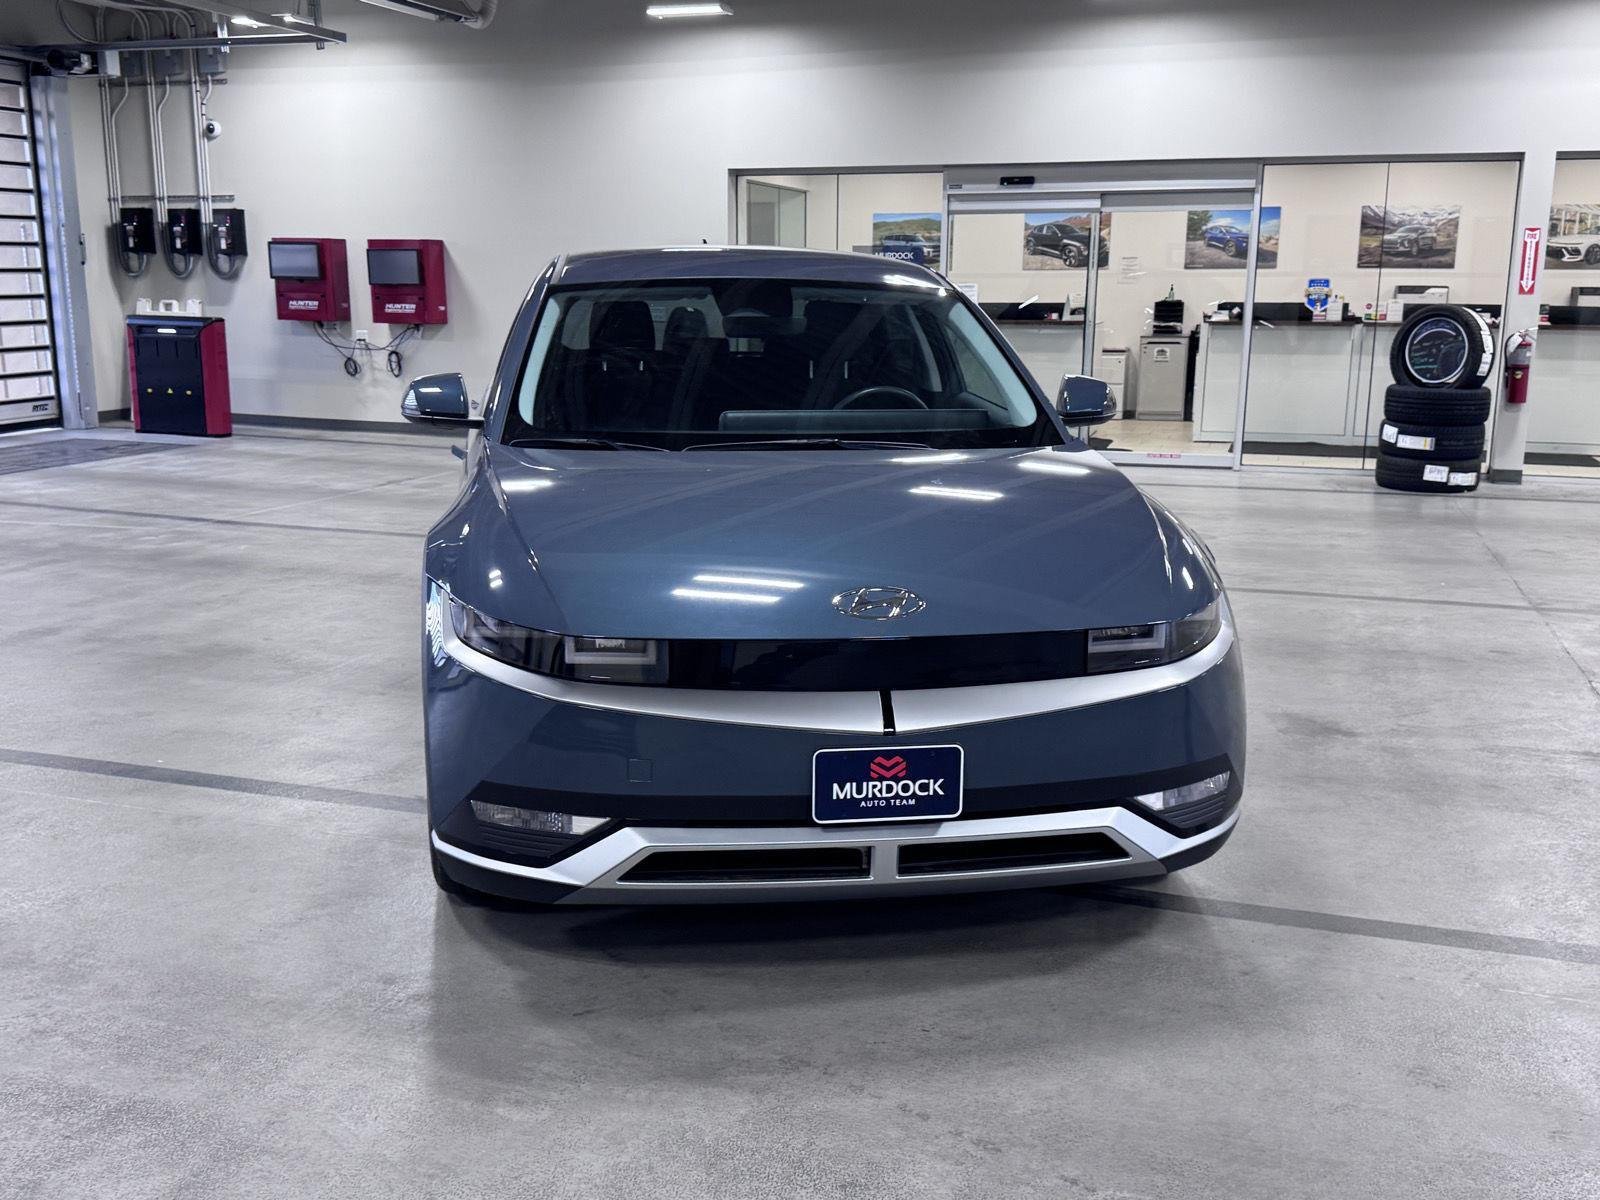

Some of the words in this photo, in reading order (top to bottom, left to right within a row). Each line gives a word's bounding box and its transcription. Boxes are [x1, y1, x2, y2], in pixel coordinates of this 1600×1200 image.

[832, 779, 945, 800] MURDOCK
[860, 800, 886, 808] AUTO
[890, 798, 916, 806] TEAM
